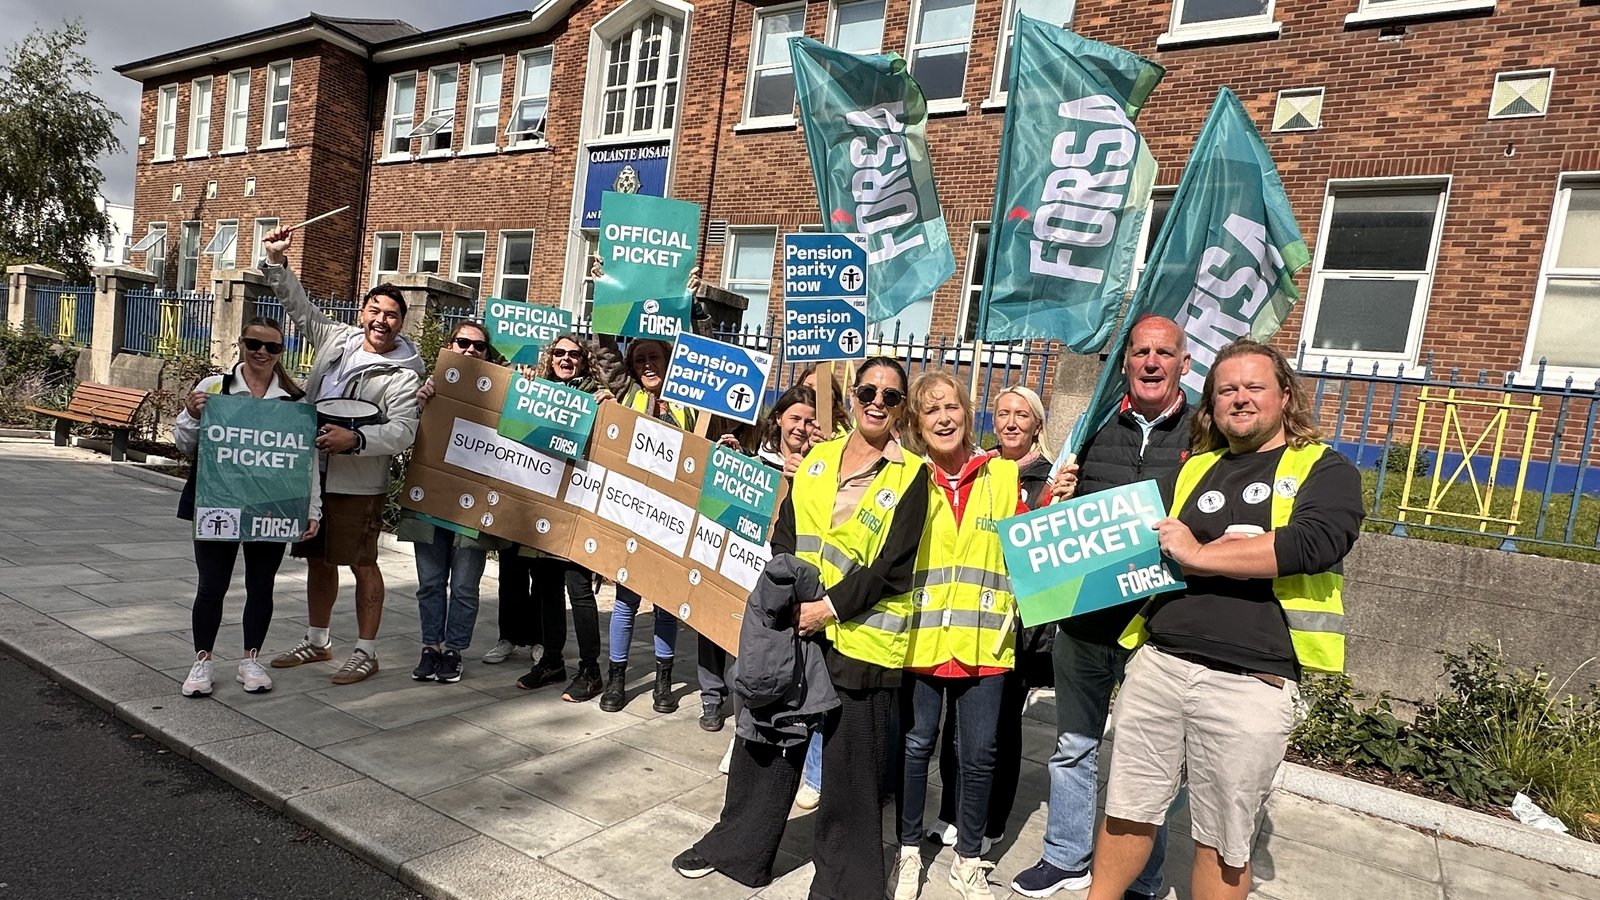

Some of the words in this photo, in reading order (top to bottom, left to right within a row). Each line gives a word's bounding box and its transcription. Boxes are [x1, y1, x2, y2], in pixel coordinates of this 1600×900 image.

[605, 224, 692, 250] OFFICIAL
[612, 245, 682, 268] PICKET
[786, 244, 852, 260] Pension
[786, 261, 837, 279] parity
[786, 280, 821, 292] now
[490, 302, 568, 328] OFFICIAL
[786, 309, 851, 324] Pension
[497, 320, 561, 341] PICKET
[786, 326, 836, 343] parity
[675, 343, 748, 378] Pension
[786, 344, 820, 355] now
[666, 380, 706, 401] now
[670, 364, 728, 391] parity
[515, 377, 592, 415] OFFICIAL
[516, 396, 581, 428] PICKET
[207, 424, 310, 450] OFFICIAL
[217, 446, 299, 469] PICKET
[712, 449, 774, 493] OFFICIAL
[453, 433, 552, 475] SUPPORTING
[571, 473, 601, 495] OUR
[606, 486, 685, 535] SECRETARIES
[696, 526, 723, 549] AND
[713, 470, 764, 508] PICKET
[856, 507, 883, 536] FÓRSA
[975, 513, 998, 534] FÓRS
[1008, 490, 1155, 548] OFFICIAL
[1028, 518, 1142, 574] PICKET
